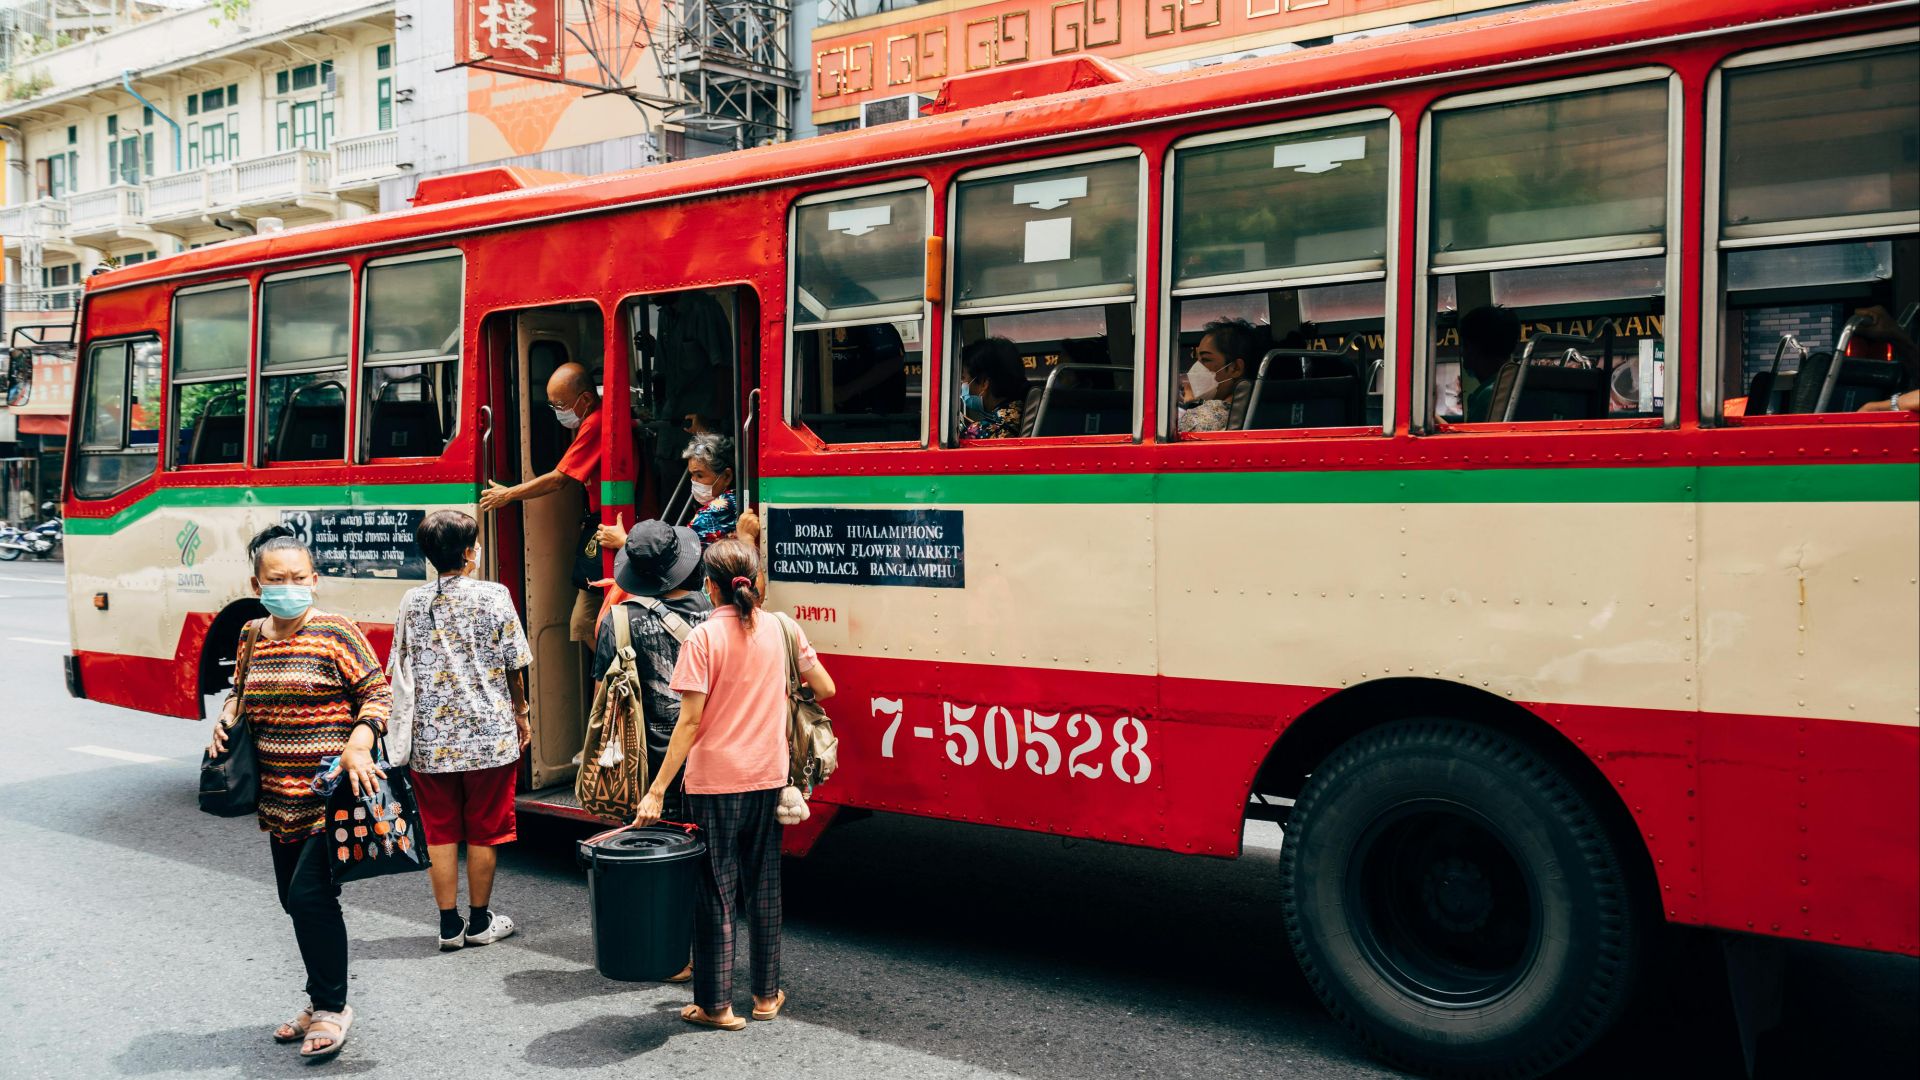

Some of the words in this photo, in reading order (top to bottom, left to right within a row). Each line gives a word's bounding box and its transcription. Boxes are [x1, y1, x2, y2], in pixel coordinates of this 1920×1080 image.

[396, 512, 409, 526] 22
[794, 524, 834, 539] BOBAE
[847, 524, 945, 540] HUALAMPHONG
[774, 541, 846, 557] CHINATOWN
[851, 543, 901, 559] FLOWER
[904, 544, 962, 560] MARKET
[773, 559, 814, 575] GRAND
[816, 560, 859, 576] PALACE
[869, 562, 957, 579] BANGLAMPHU
[870, 695, 1153, 786] 7-50528
